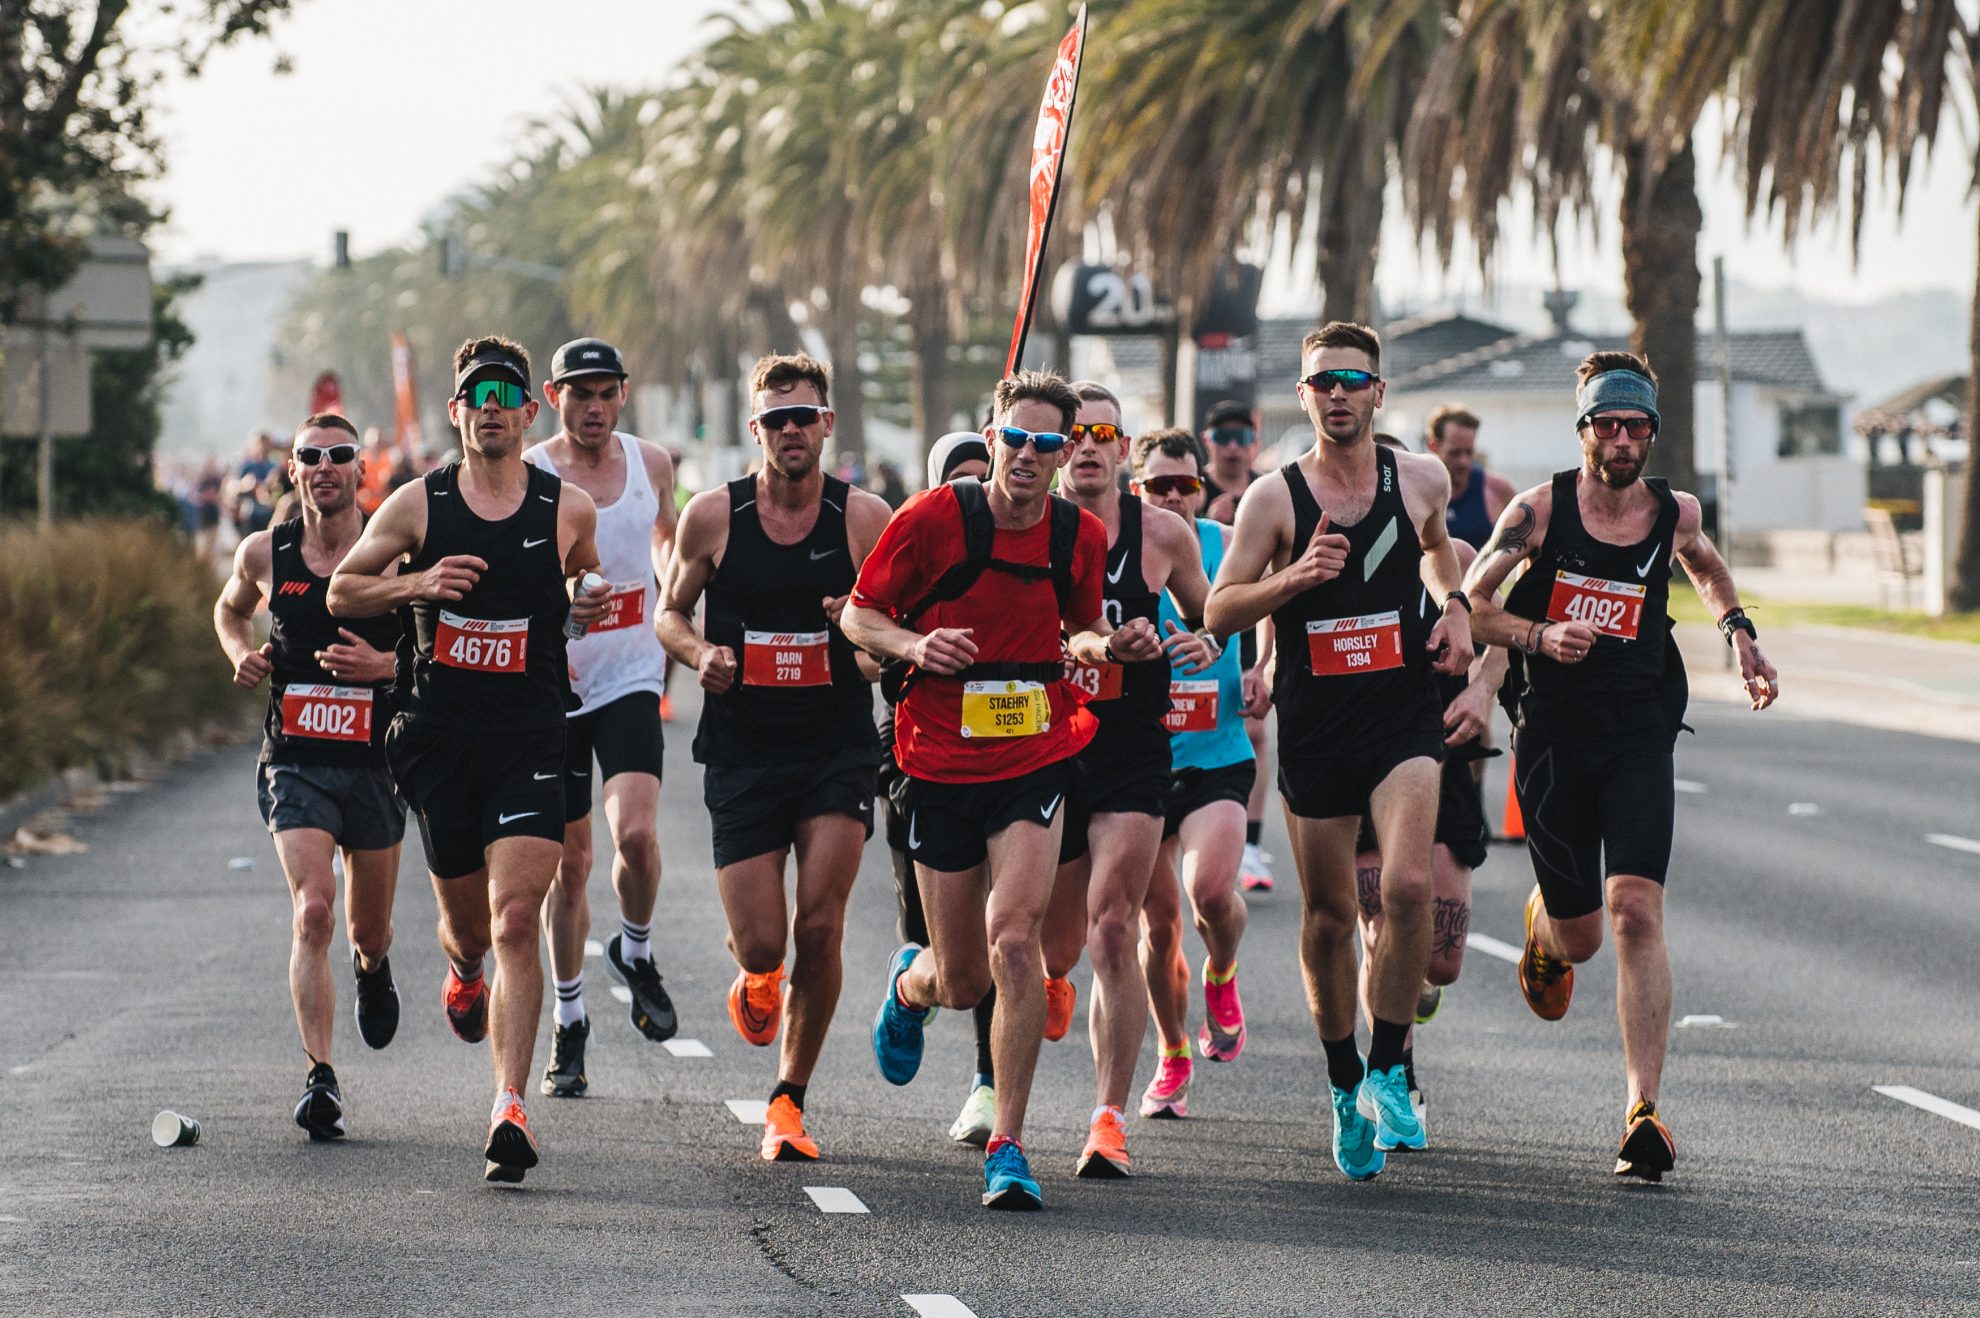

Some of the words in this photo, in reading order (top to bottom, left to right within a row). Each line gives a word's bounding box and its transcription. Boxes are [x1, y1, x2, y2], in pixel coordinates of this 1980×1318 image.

[1383, 464, 1392, 492] soar
[1564, 593, 1627, 631] 4092
[449, 635, 512, 668] 4676
[1332, 633, 1378, 653] HORSLEY
[776, 651, 803, 666] BARN
[1345, 651, 1372, 667] 1394
[776, 666, 802, 681] 2719
[988, 695, 1030, 711] STAEHRY
[297, 701, 356, 736] 4002
[994, 712, 1025, 727] S1253
